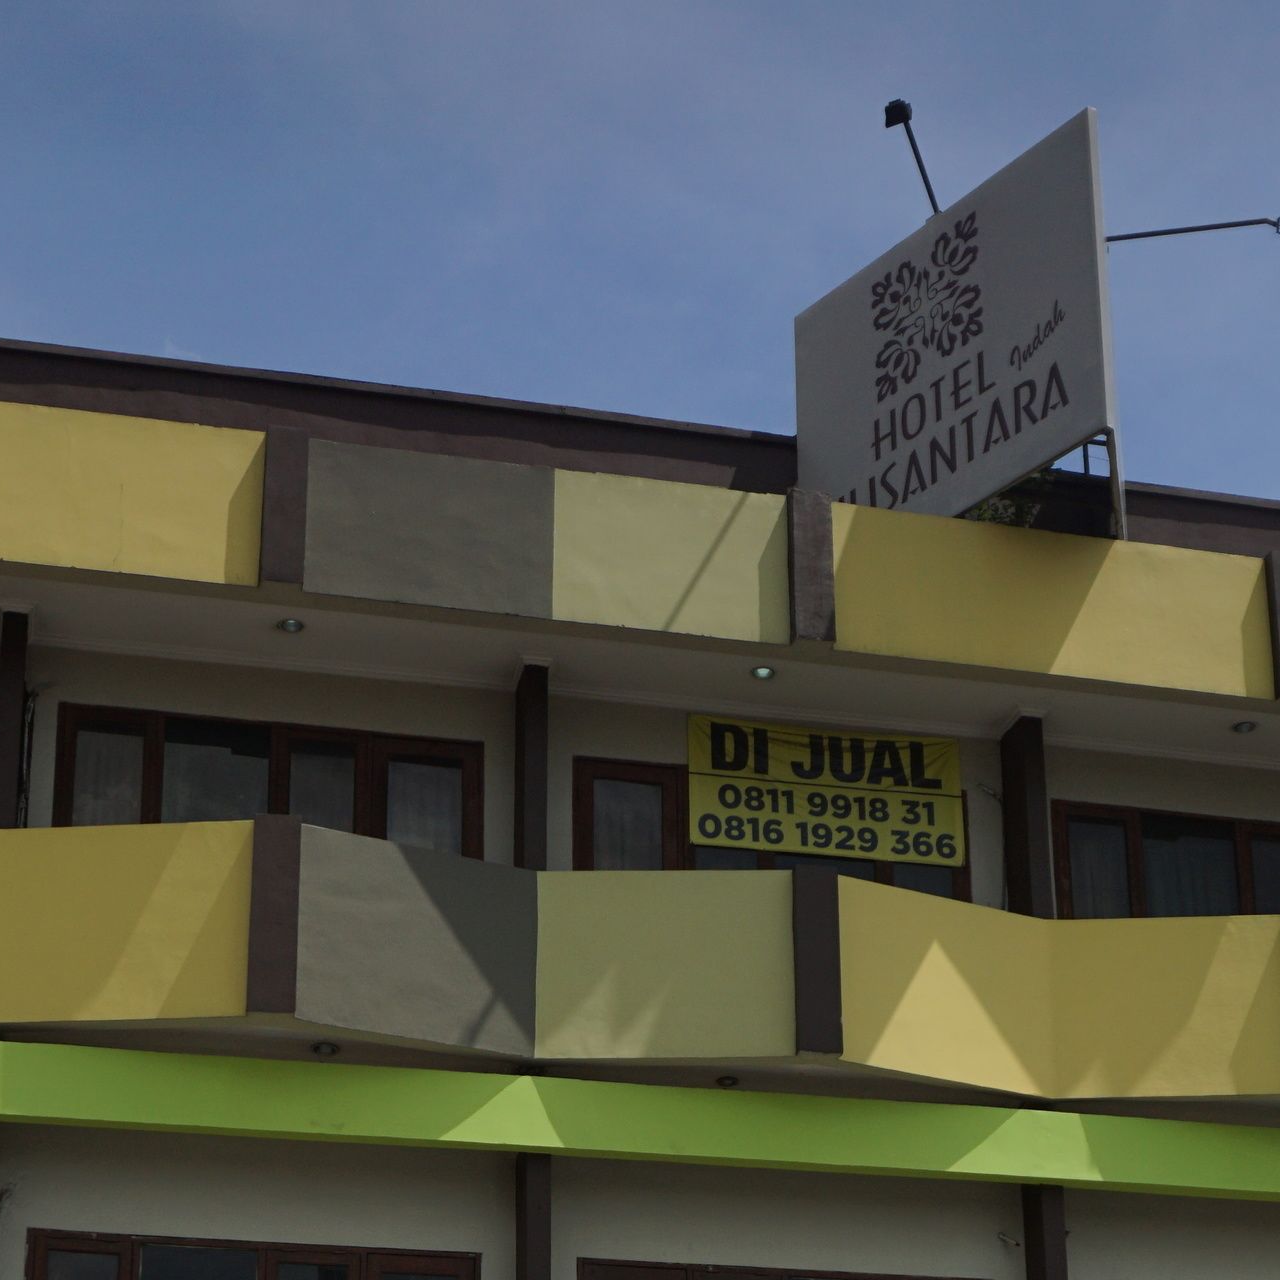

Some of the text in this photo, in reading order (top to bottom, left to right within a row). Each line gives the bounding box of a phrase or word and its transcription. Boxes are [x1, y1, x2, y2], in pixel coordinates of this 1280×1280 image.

[1009, 299, 1066, 371] Indah
[872, 351, 996, 461] HOTEL
[710, 722, 942, 790] DI JUAL
[698, 813, 957, 859] 0816 1929 366
[718, 783, 935, 826] 0811 9918 31
